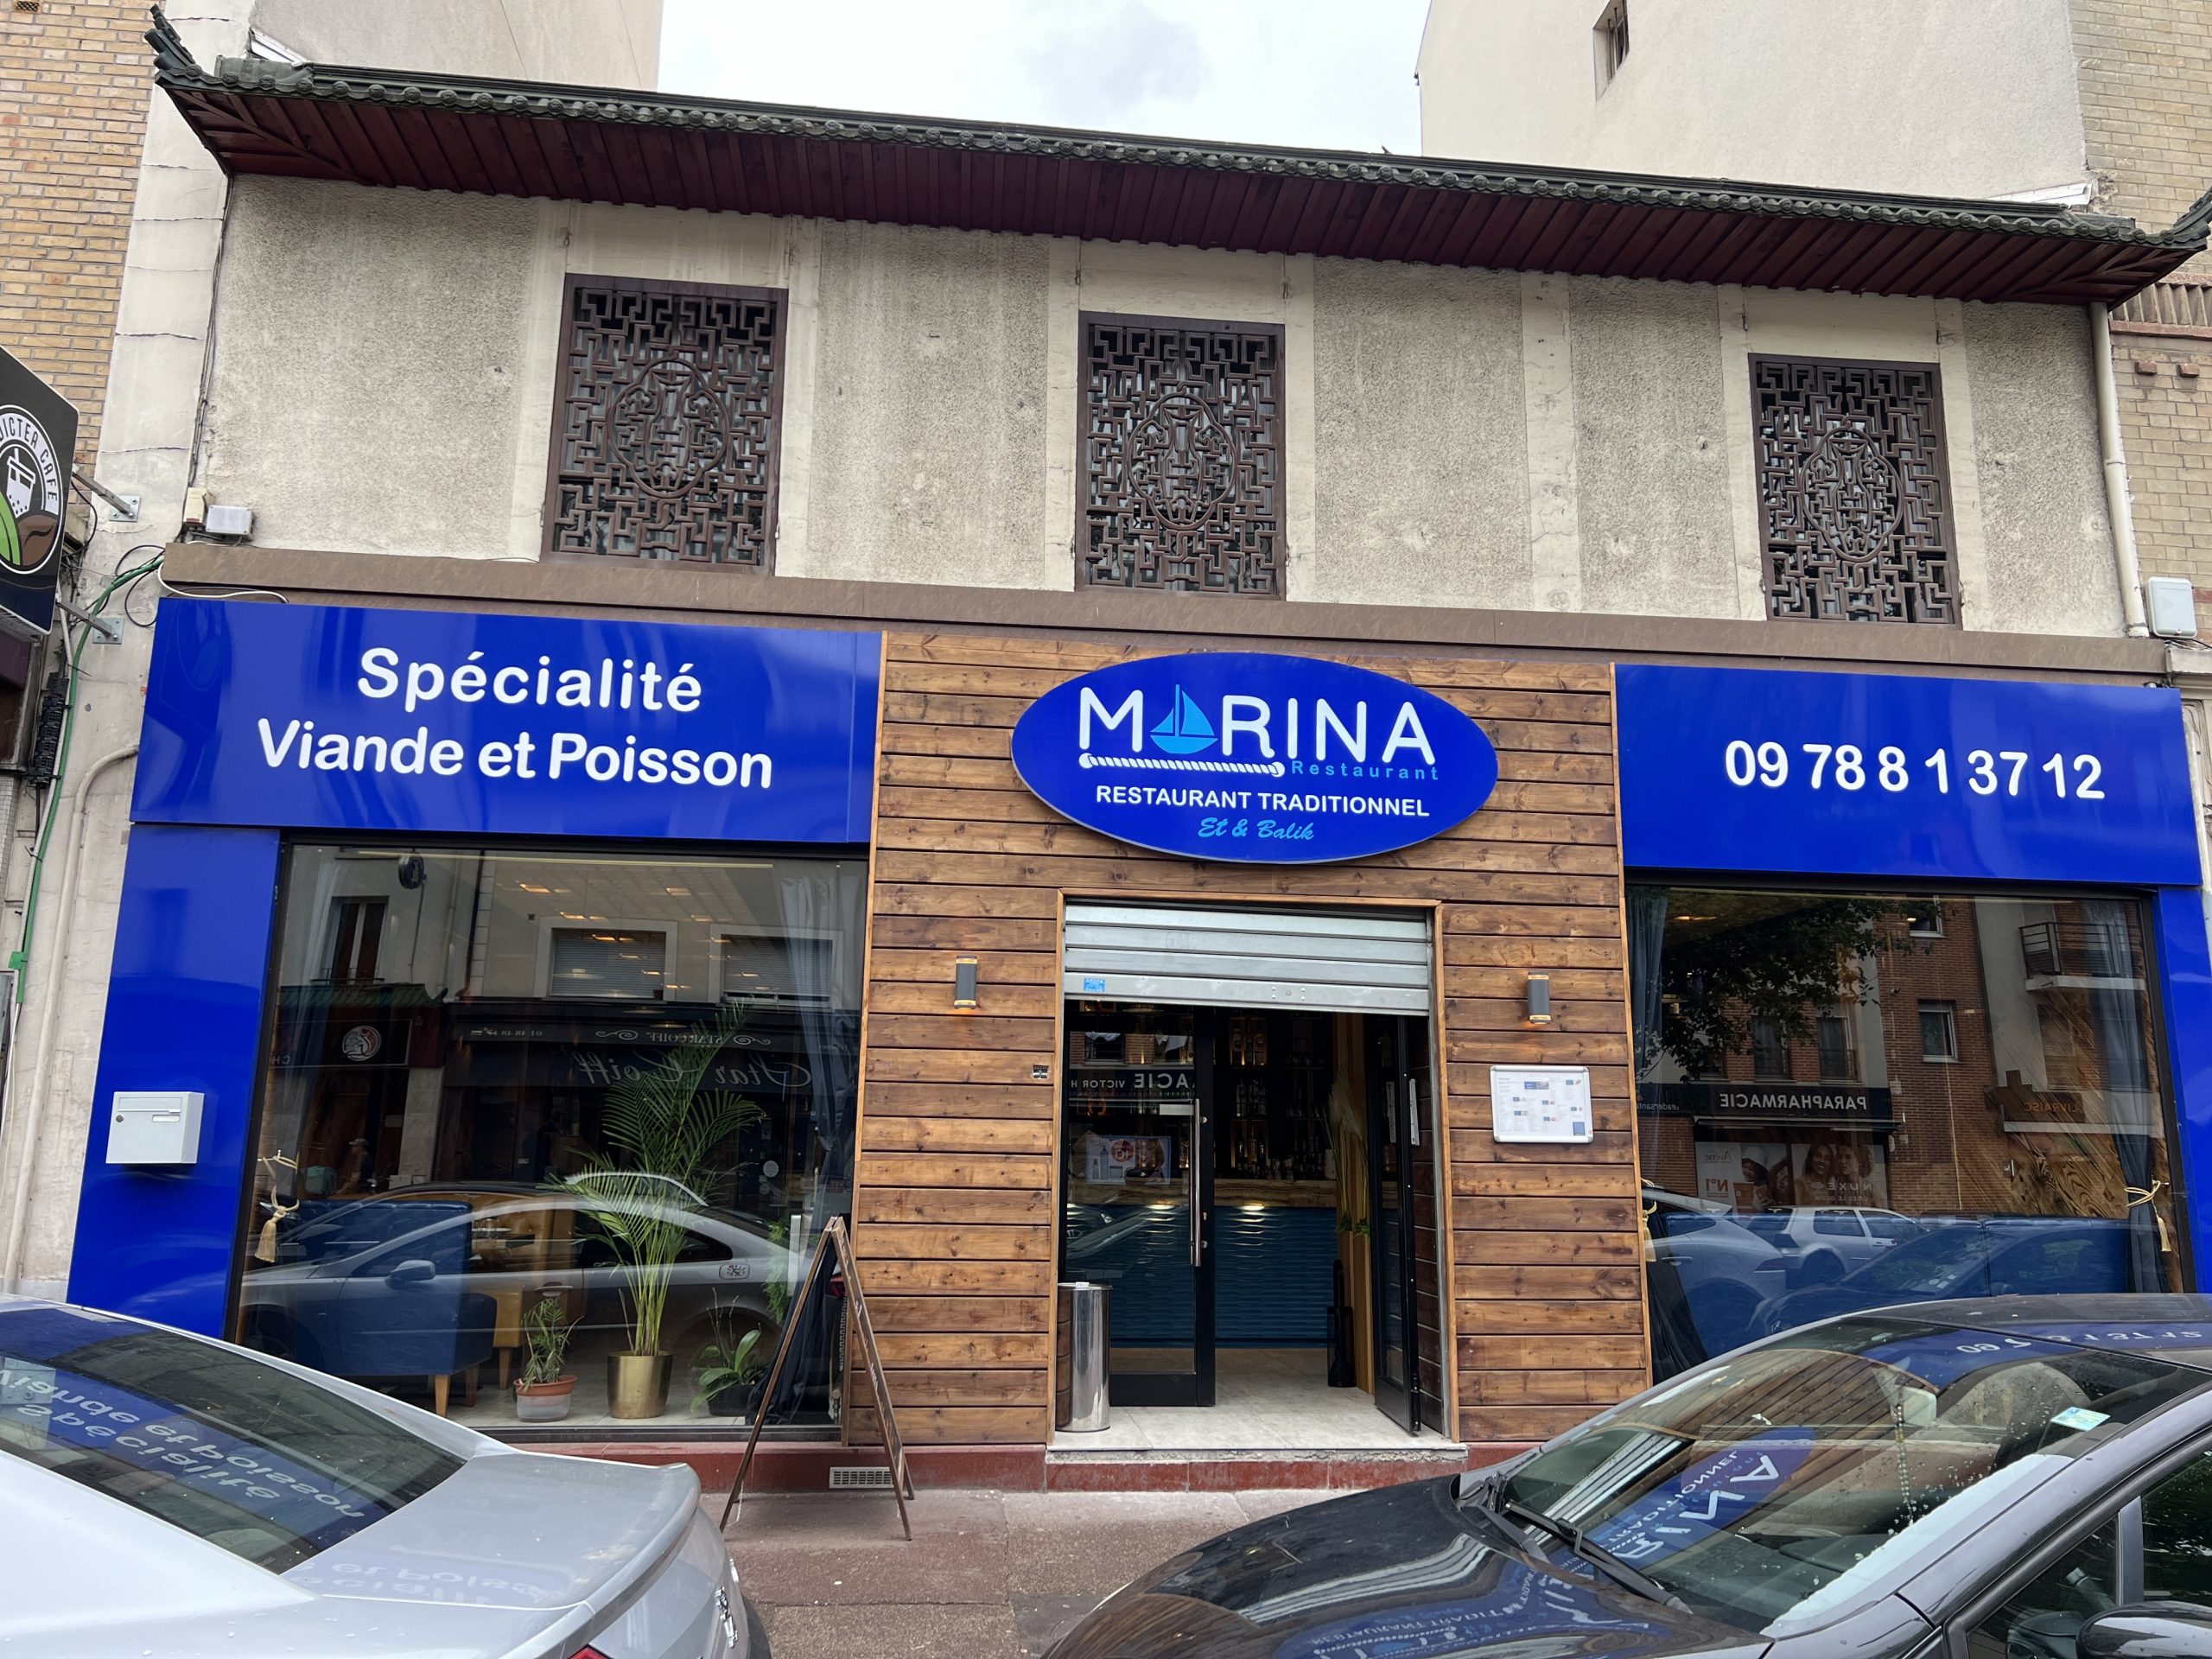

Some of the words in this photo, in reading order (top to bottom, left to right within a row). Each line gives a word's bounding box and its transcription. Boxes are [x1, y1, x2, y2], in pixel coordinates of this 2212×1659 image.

[40, 448, 58, 501] CAFE
[357, 646, 702, 714] Spécialité
[257, 717, 464, 777] Viande
[478, 730, 536, 779] et
[549, 731, 772, 789] Poisson
[1291, 760, 1439, 780] Restaurant
[1725, 740, 1789, 788] 09
[1802, 743, 1866, 791] 78
[1967, 749, 2029, 798] 37
[2042, 752, 2106, 800] 12
[1096, 785, 1252, 810] RESTAURANT
[1257, 791, 1430, 817] TRADITIONNEL
[1231, 818, 1249, 837] &
[1256, 819, 1314, 840] Balik
